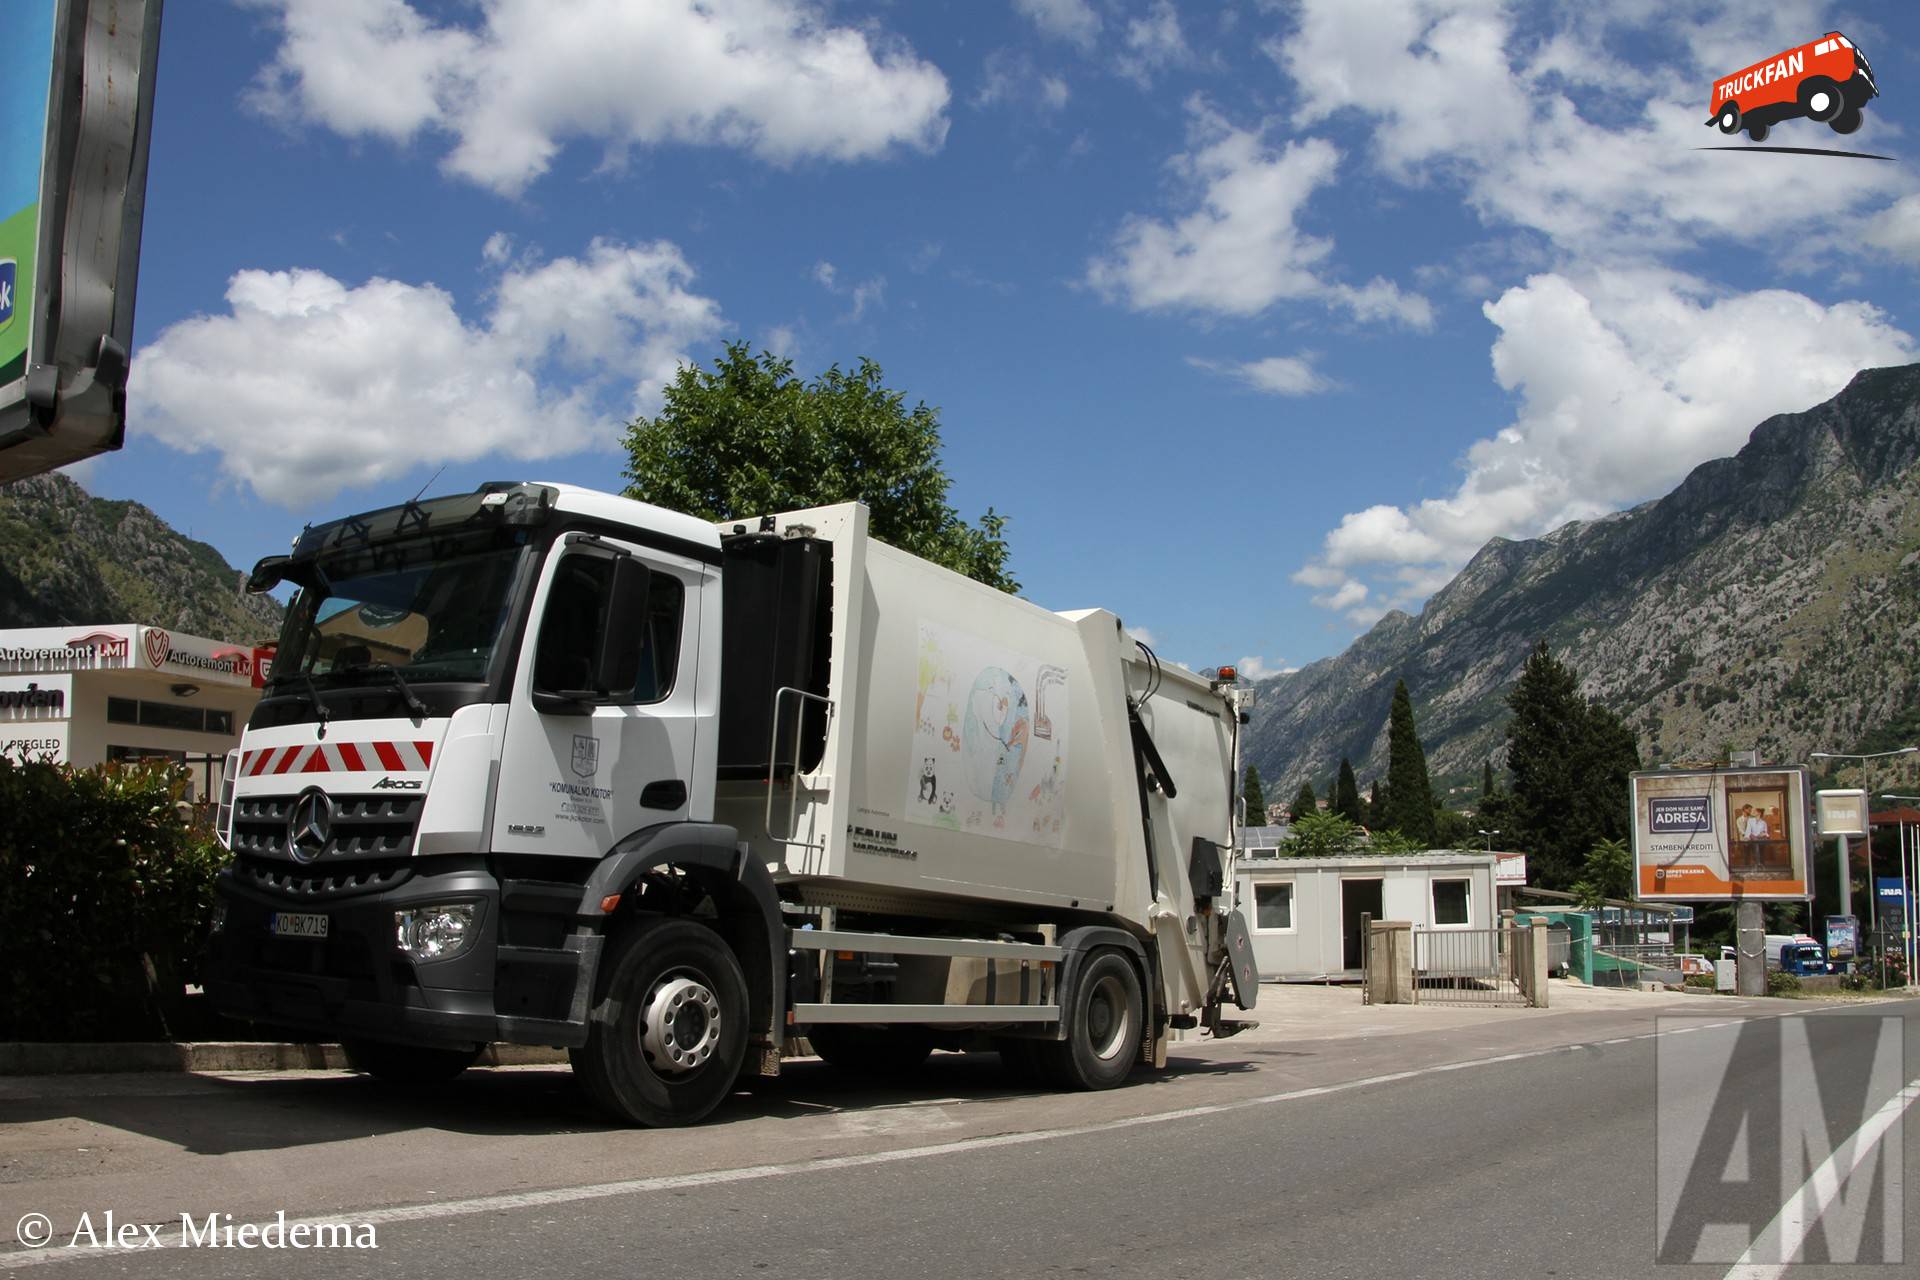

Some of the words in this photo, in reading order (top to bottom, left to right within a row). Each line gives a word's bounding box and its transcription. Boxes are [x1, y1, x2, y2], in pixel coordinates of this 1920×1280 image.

[0, 645, 94, 661] Autoremont
[98, 642, 126, 657] LMI
[168, 650, 235, 673] Autoremont
[9, 739, 60, 750] PREGLED
[1655, 812, 1706, 824] ADRESA
[1650, 844, 1684, 852] STAMBENI
[294, 916, 327, 935] BK719
